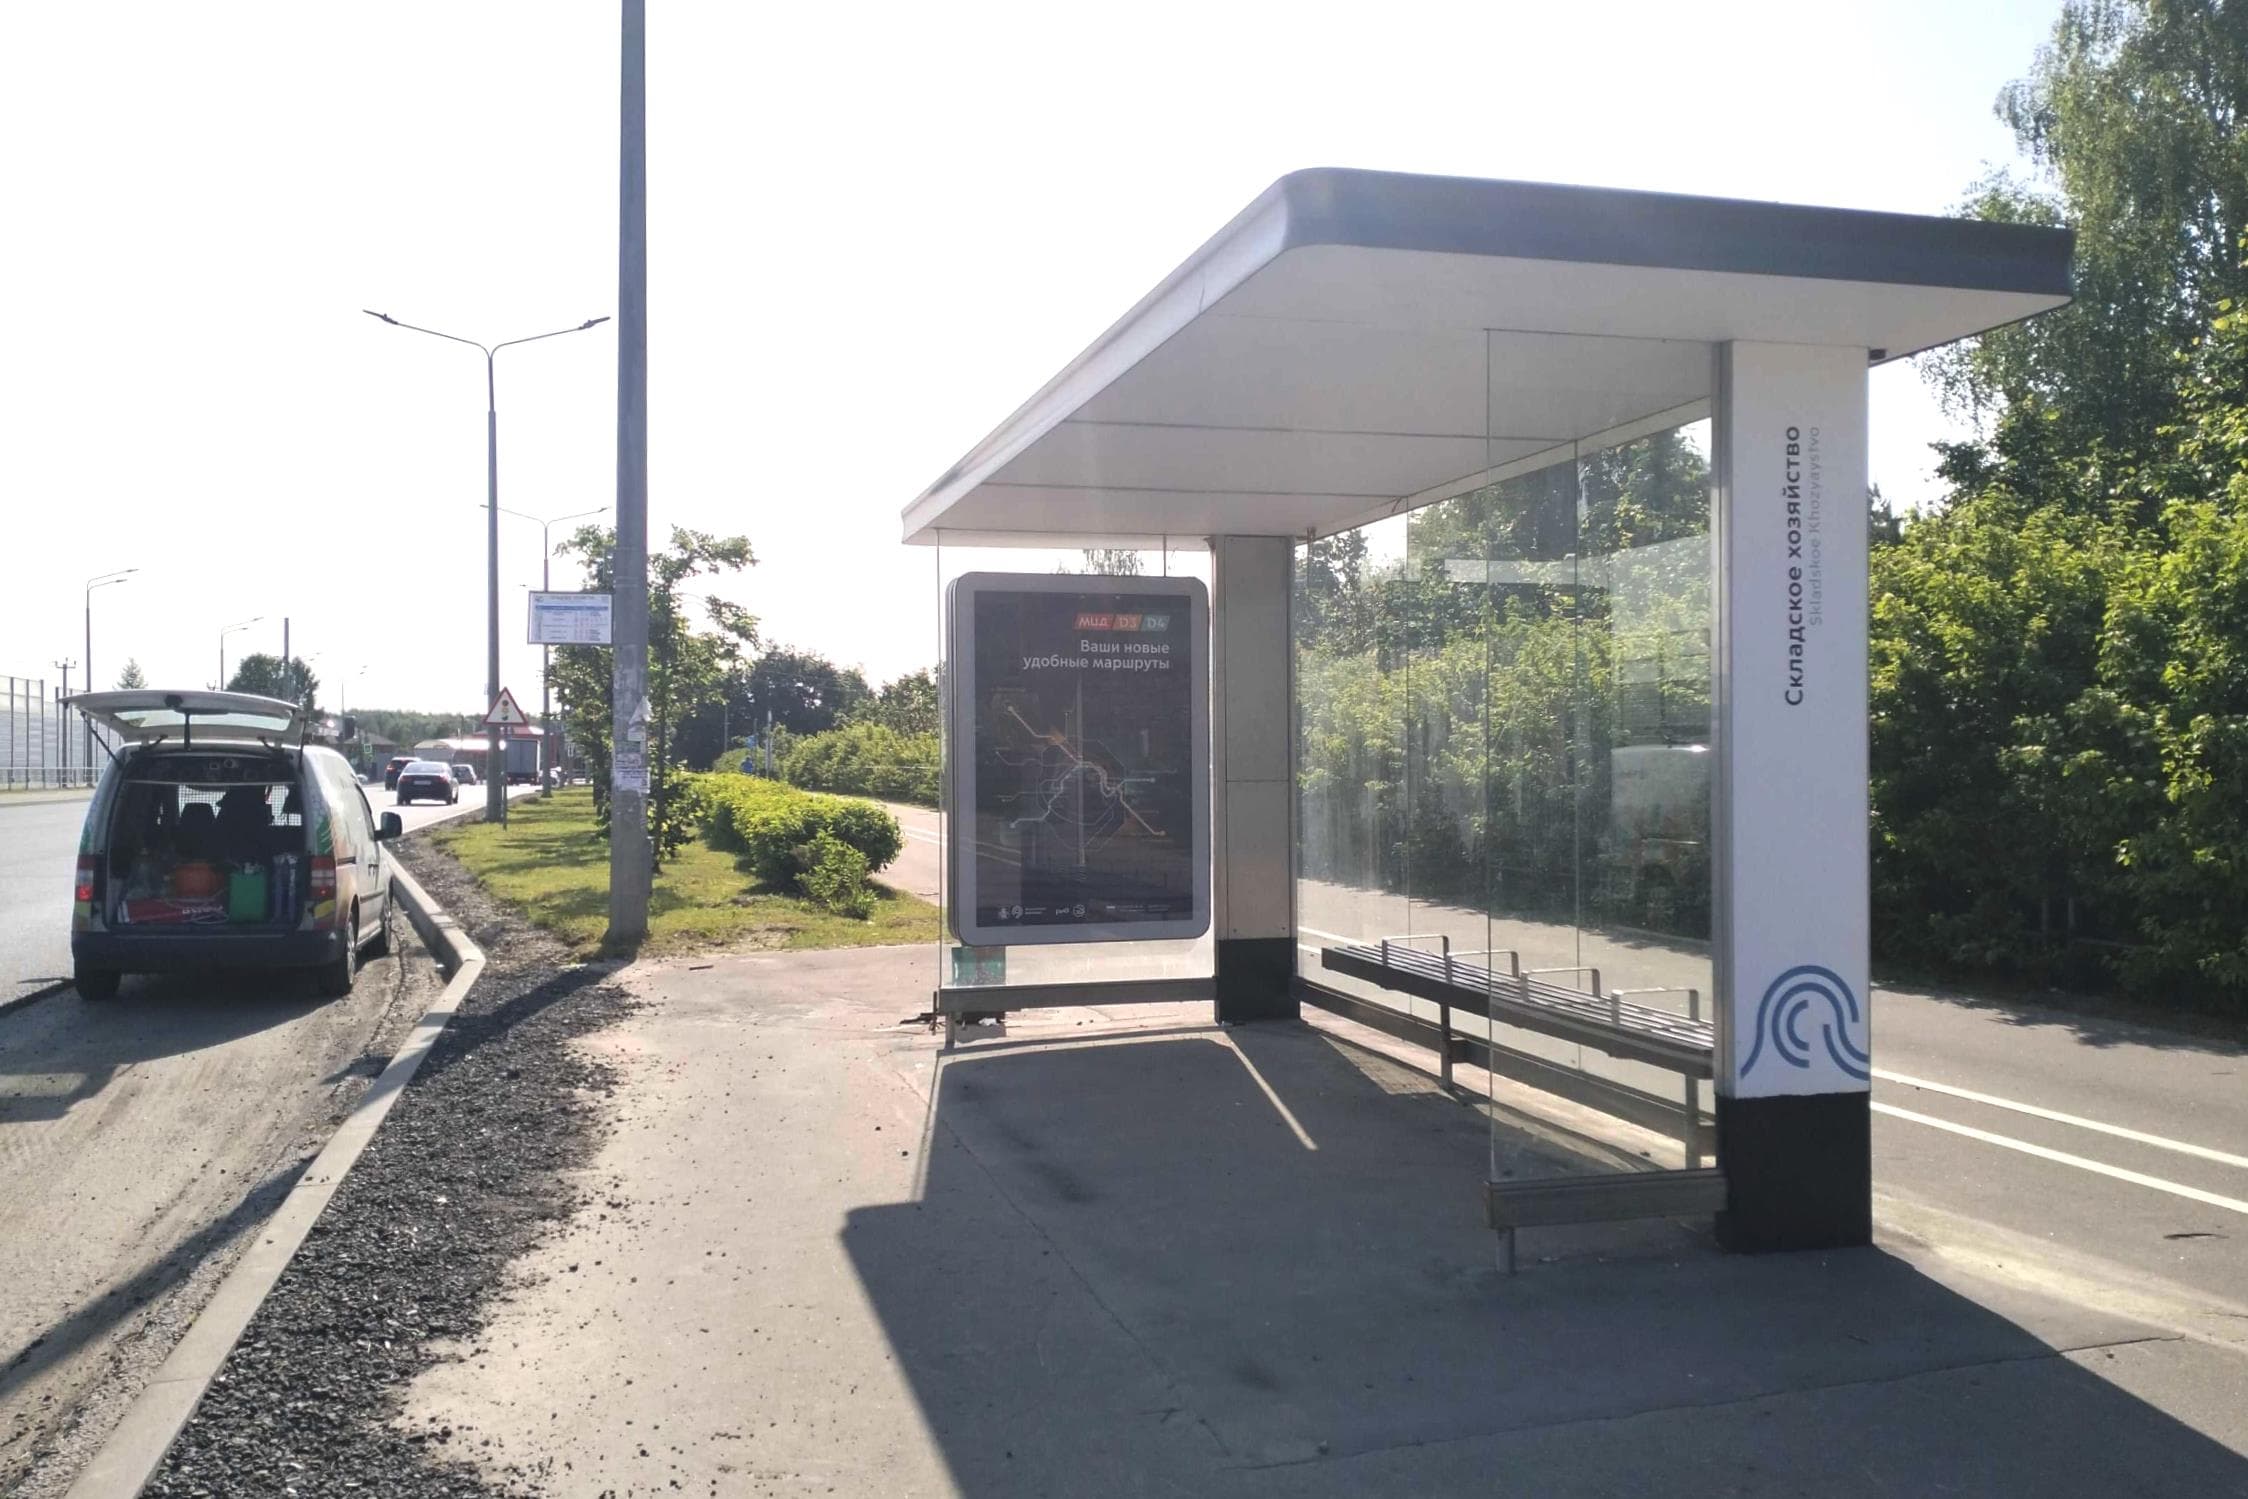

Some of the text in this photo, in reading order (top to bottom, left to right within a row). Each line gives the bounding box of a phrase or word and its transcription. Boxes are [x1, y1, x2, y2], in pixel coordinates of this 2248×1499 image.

[1782, 425, 1806, 706] Складское хозяйство
[1807, 426, 1823, 626] Skladskoe Khozyaystvo
[1022, 654, 1170, 672] удобные маршруты
[1080, 639, 1170, 654] Ваши новые
